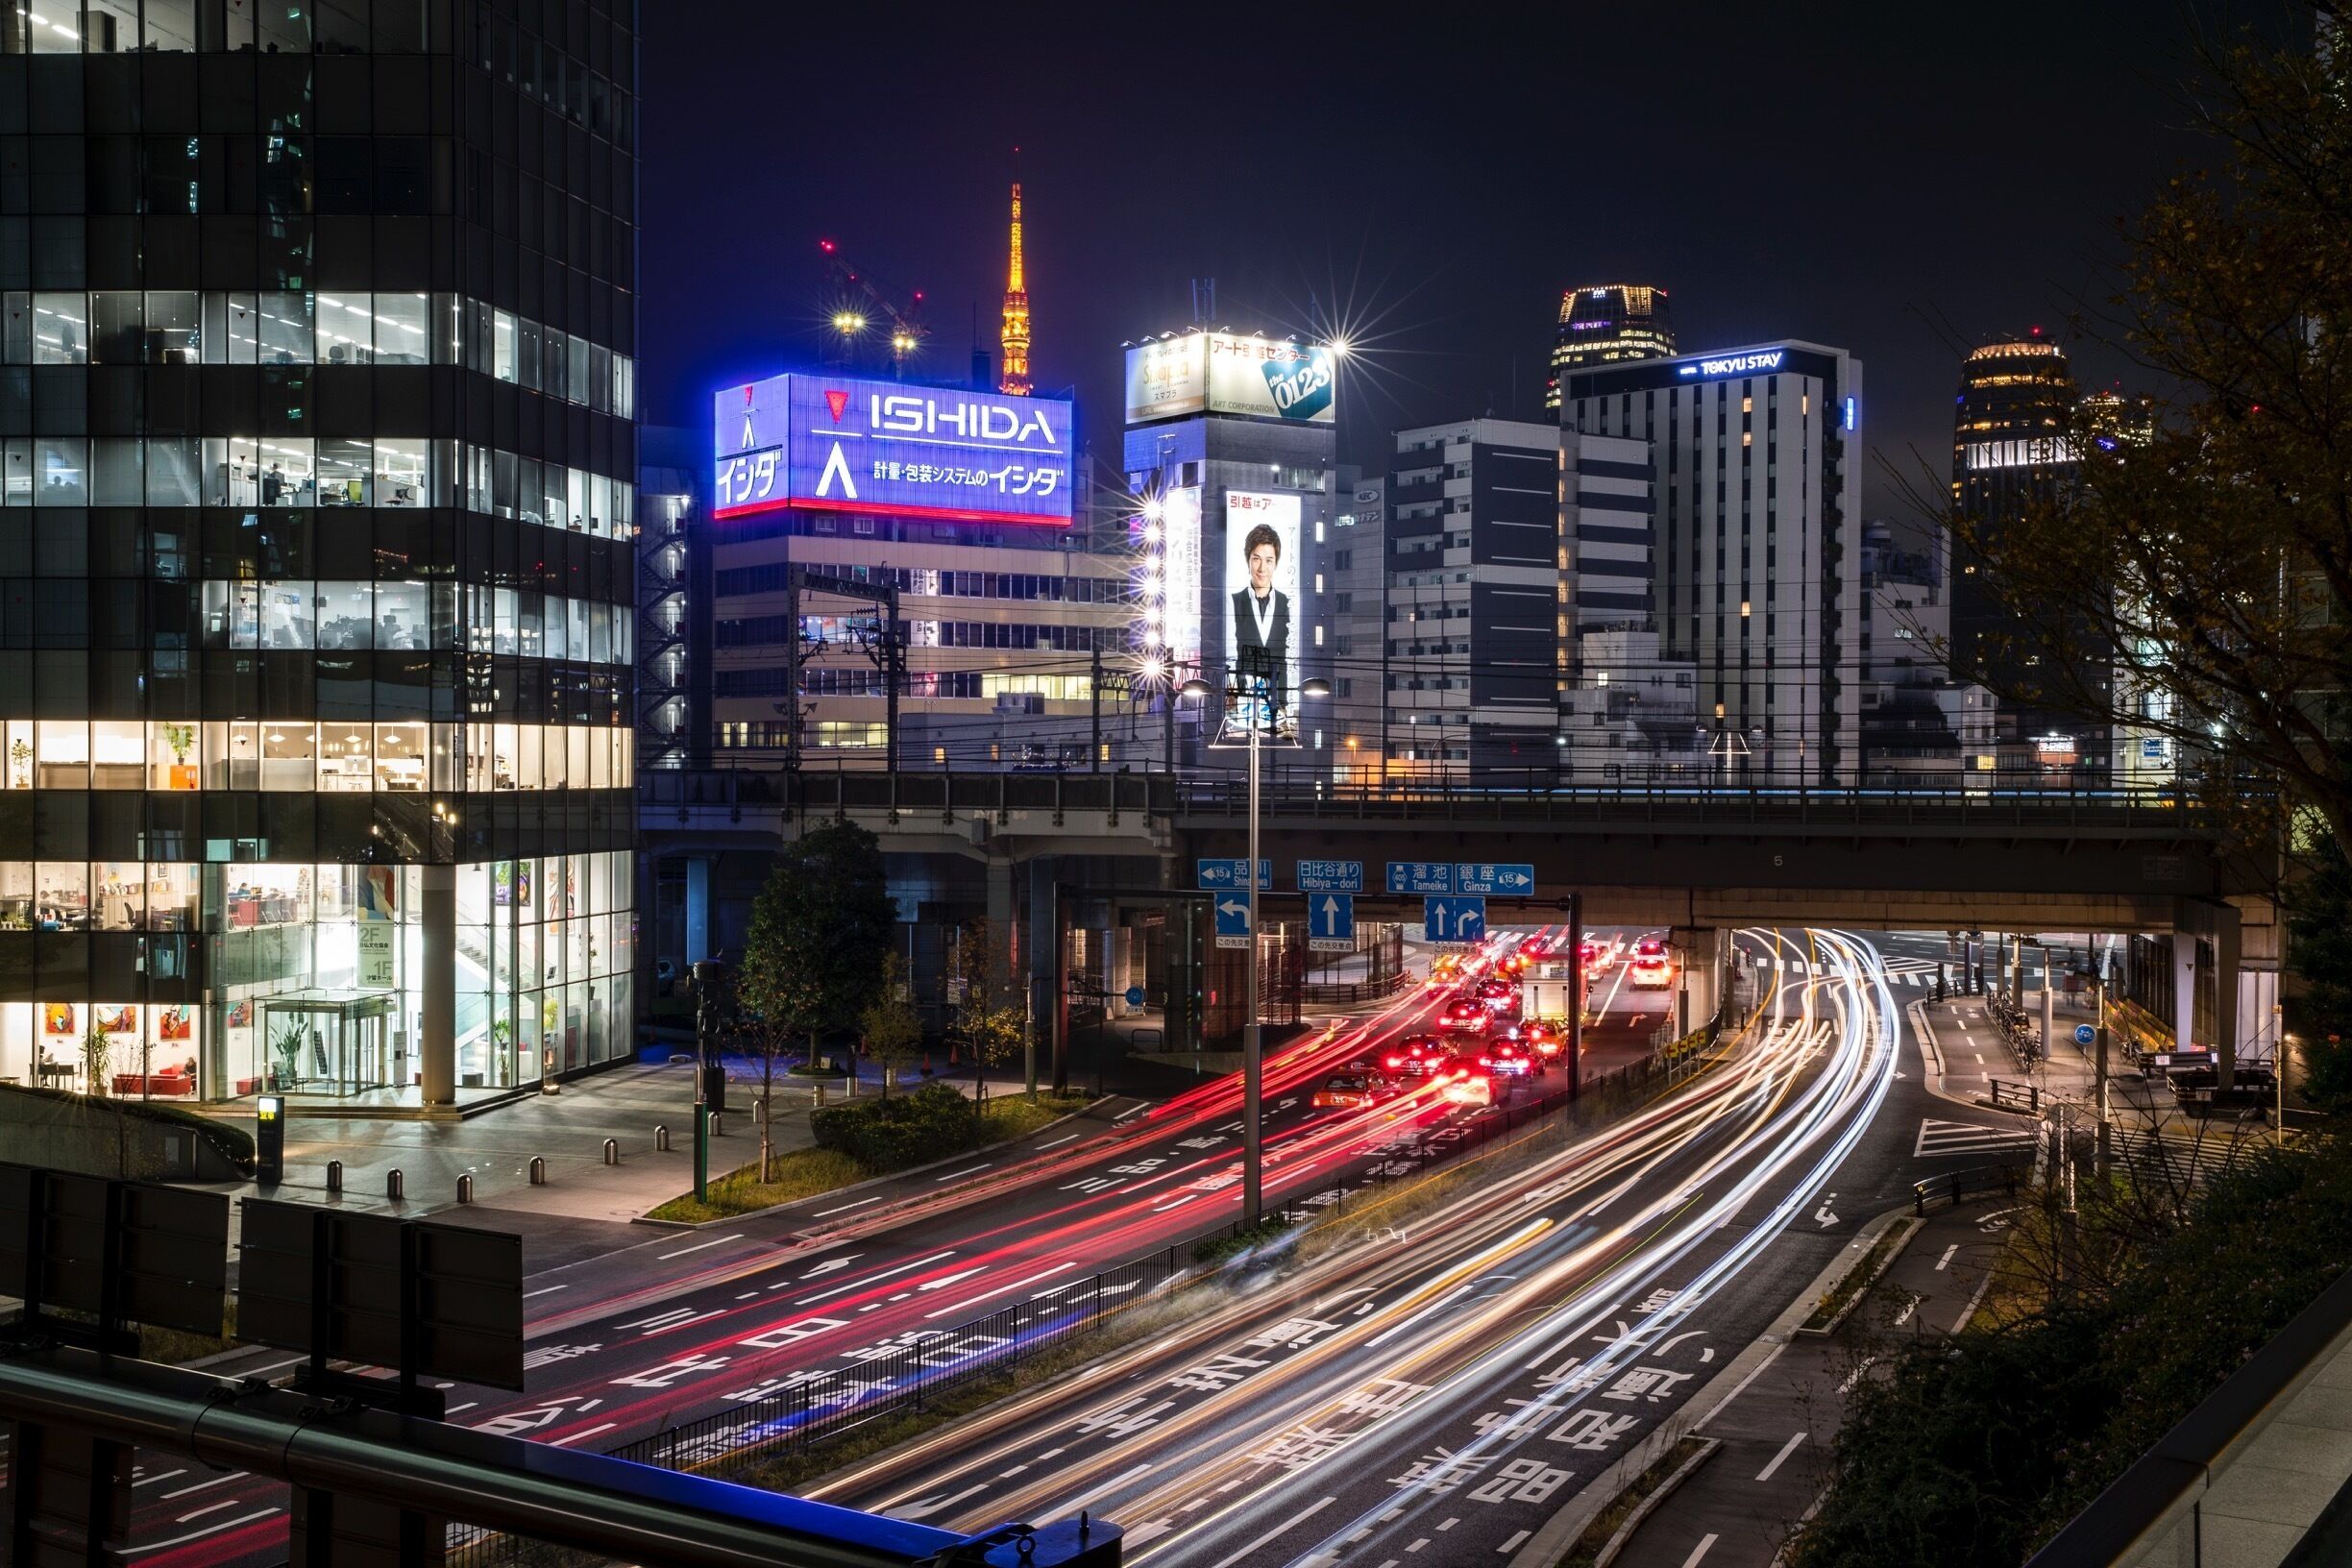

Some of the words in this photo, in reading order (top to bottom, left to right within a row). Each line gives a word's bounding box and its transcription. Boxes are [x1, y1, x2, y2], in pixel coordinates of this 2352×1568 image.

[1701, 357, 1746, 375] TOKYU
[1748, 352, 1782, 369] STAY
[1268, 373, 1285, 388] the
[1275, 354, 1331, 409] 0123
[1213, 400, 1227, 409] ART
[1228, 401, 1275, 413] CORPORATION
[870, 394, 1056, 443] ISHIDA
[717, 448, 783, 503] イシダ
[1215, 869, 1225, 877] 15
[1300, 862, 1360, 877] 日比谷通り
[1412, 865, 1448, 879] 溜池
[1459, 866, 1495, 881] 銀座
[1504, 873, 1514, 882] 15
[1234, 875, 1267, 887] Shinawa
[1412, 880, 1448, 892] Tameike
[1463, 880, 1491, 893] Ginza
[359, 926, 380, 942] 2F
[374, 960, 392, 976] 1F
[1467, 1330, 1714, 1505] 昭和通り
